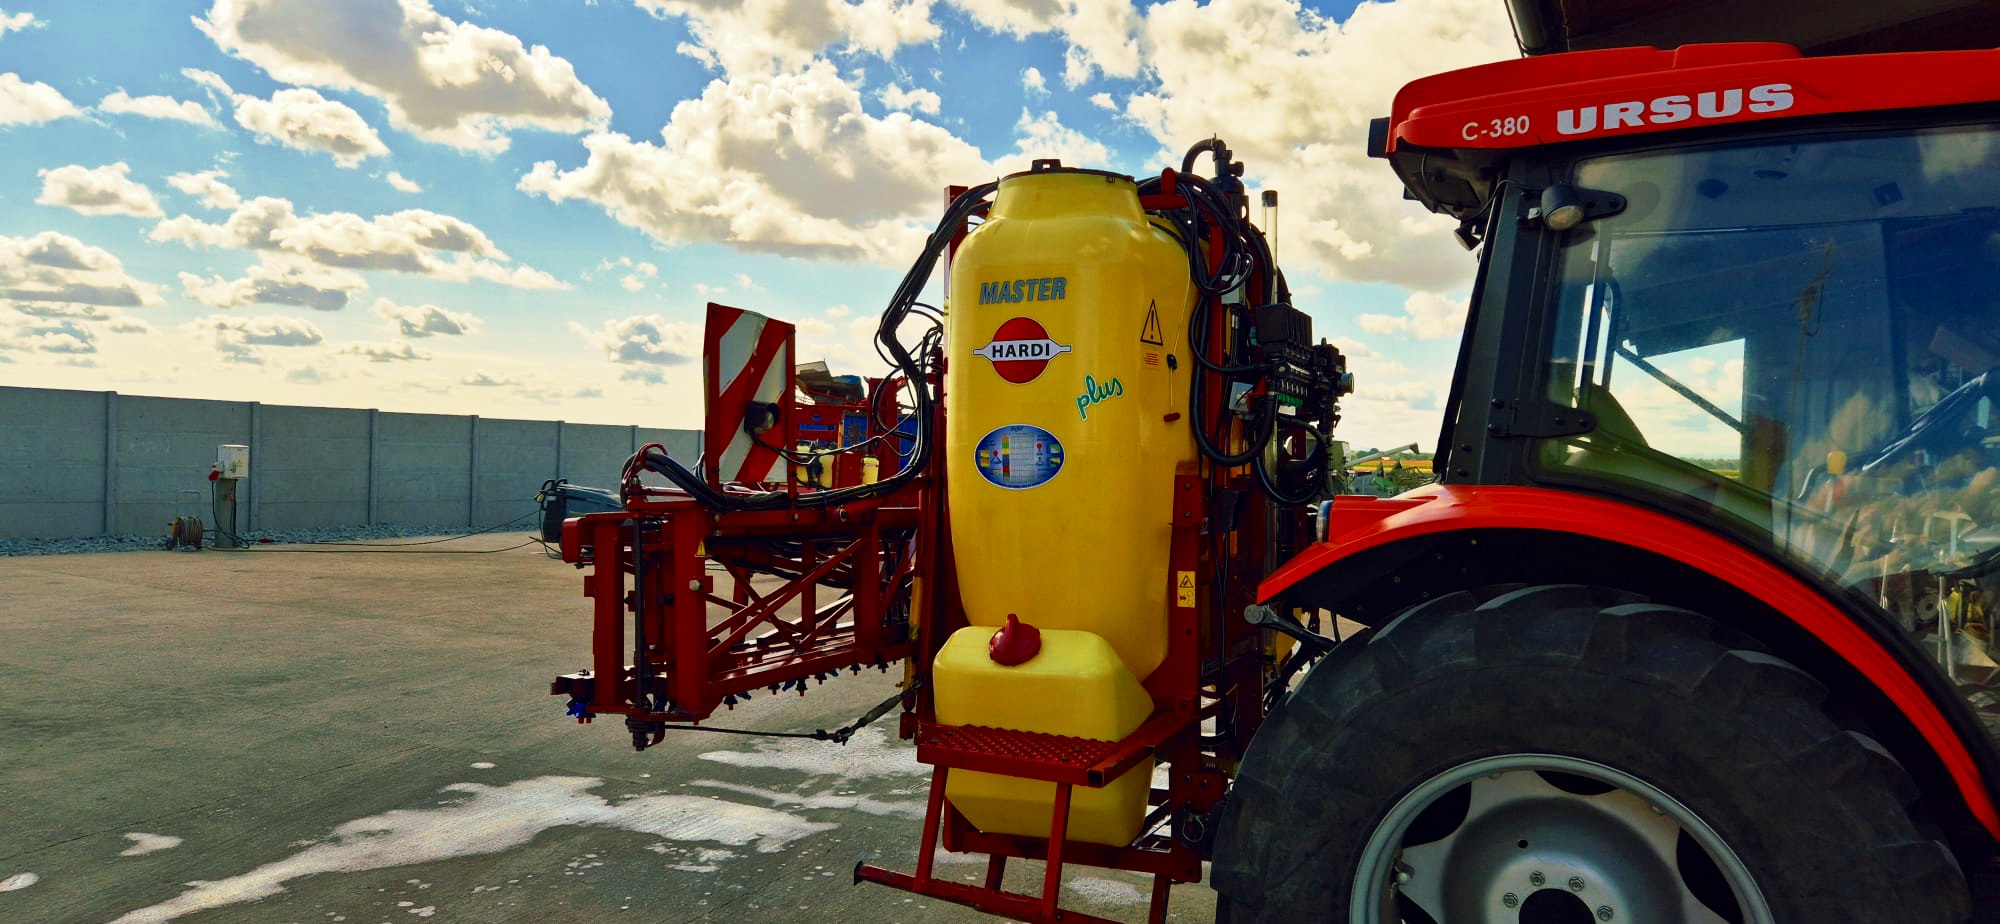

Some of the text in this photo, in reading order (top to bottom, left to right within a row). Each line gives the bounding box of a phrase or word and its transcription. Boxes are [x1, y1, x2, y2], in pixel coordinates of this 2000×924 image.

[1462, 83, 1794, 141] C-380 URSUS
[979, 277, 1067, 305] MASTER
[992, 342, 1050, 359] HARDI
[1076, 374, 1124, 421] plus
